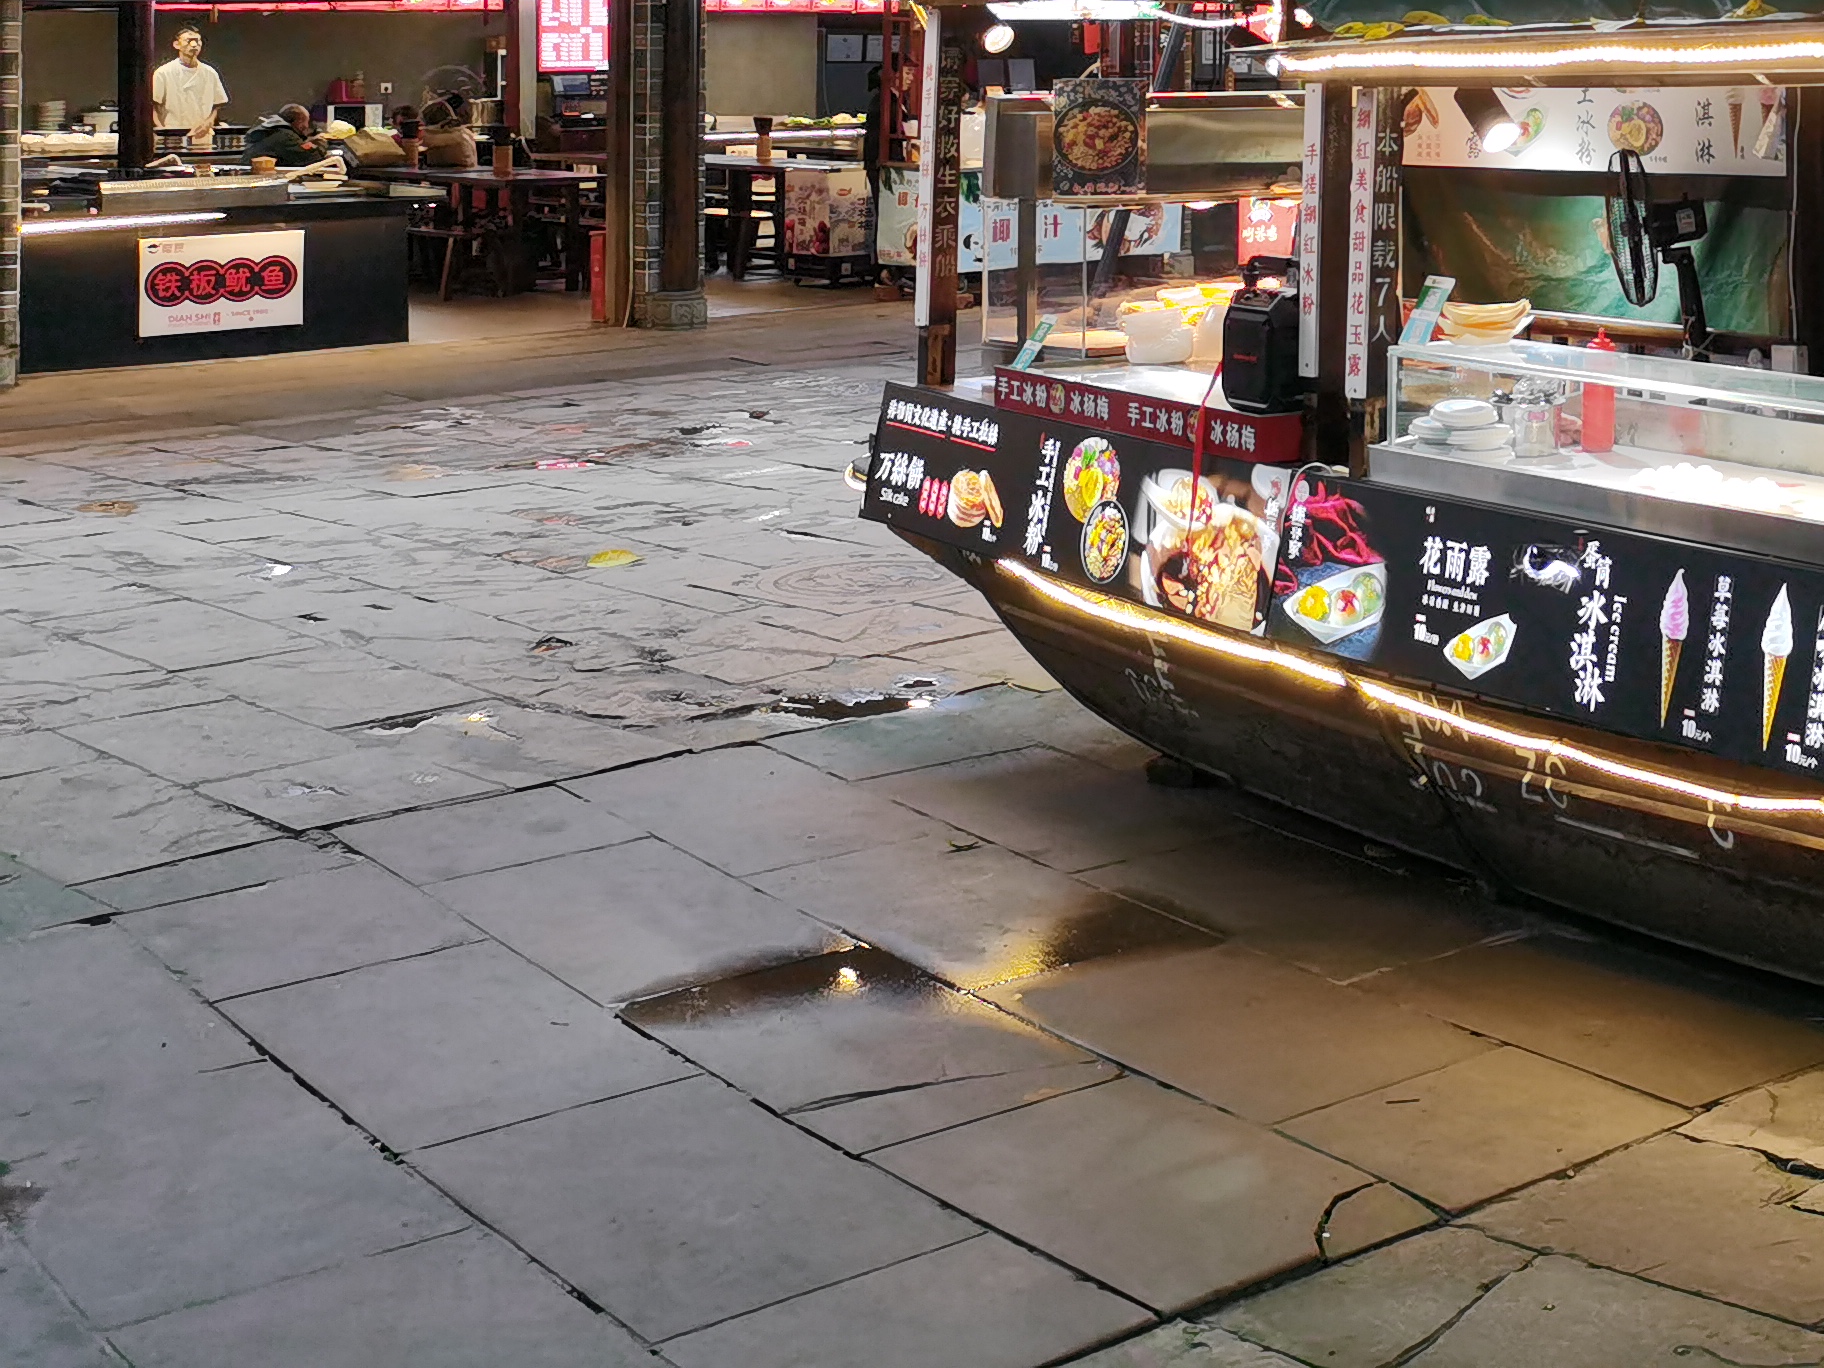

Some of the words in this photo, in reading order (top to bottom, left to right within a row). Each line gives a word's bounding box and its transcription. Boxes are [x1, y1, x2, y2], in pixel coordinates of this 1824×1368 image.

[154, 265, 286, 298] 铁板鱿鱼
[998, 376, 1048, 408] 手工冰粉
[1070, 392, 1109, 421] 冰杨梅
[1127, 402, 1184, 436] 手工冰粉
[1210, 419, 1256, 453] 冰杨梅
[1022, 438, 1055, 556] 手工冰粉
[1419, 536, 1492, 586] 花雨露
[1612, 595, 1628, 624] Ice
[1604, 624, 1620, 683] cream
